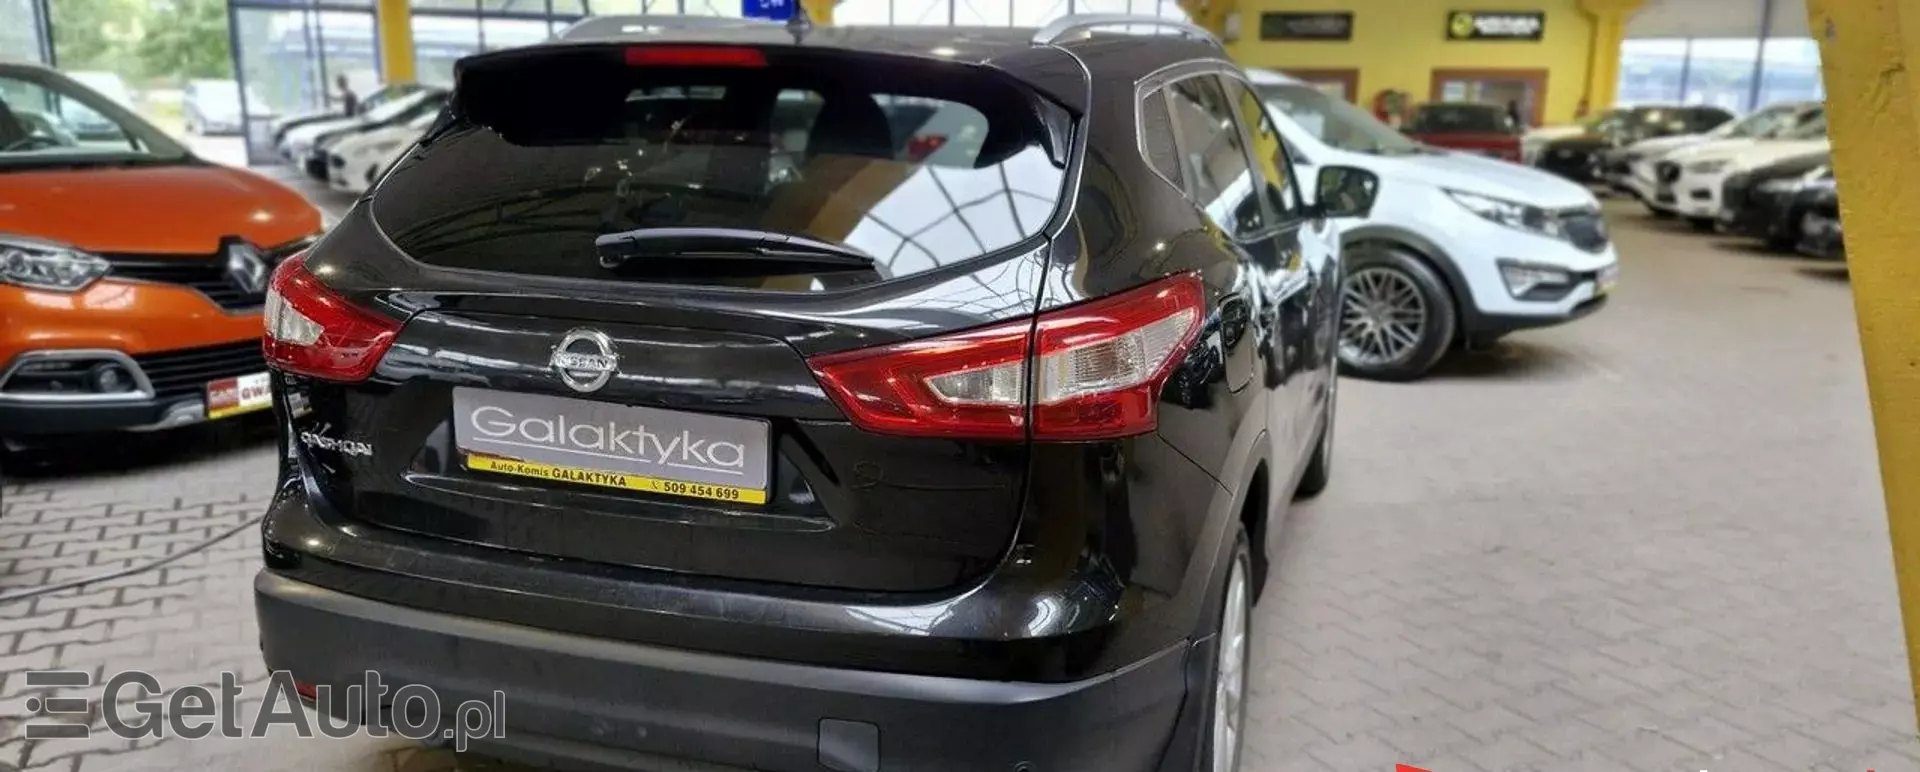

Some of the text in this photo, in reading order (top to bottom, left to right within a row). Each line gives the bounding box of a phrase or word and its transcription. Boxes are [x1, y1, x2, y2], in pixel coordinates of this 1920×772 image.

[555, 353, 612, 370] NISSAN
[300, 431, 373, 456] QASHQAI
[471, 406, 745, 468] Galaktyka
[490, 461, 740, 500] Auto-Komis GALAKTYKA 509 454 699
